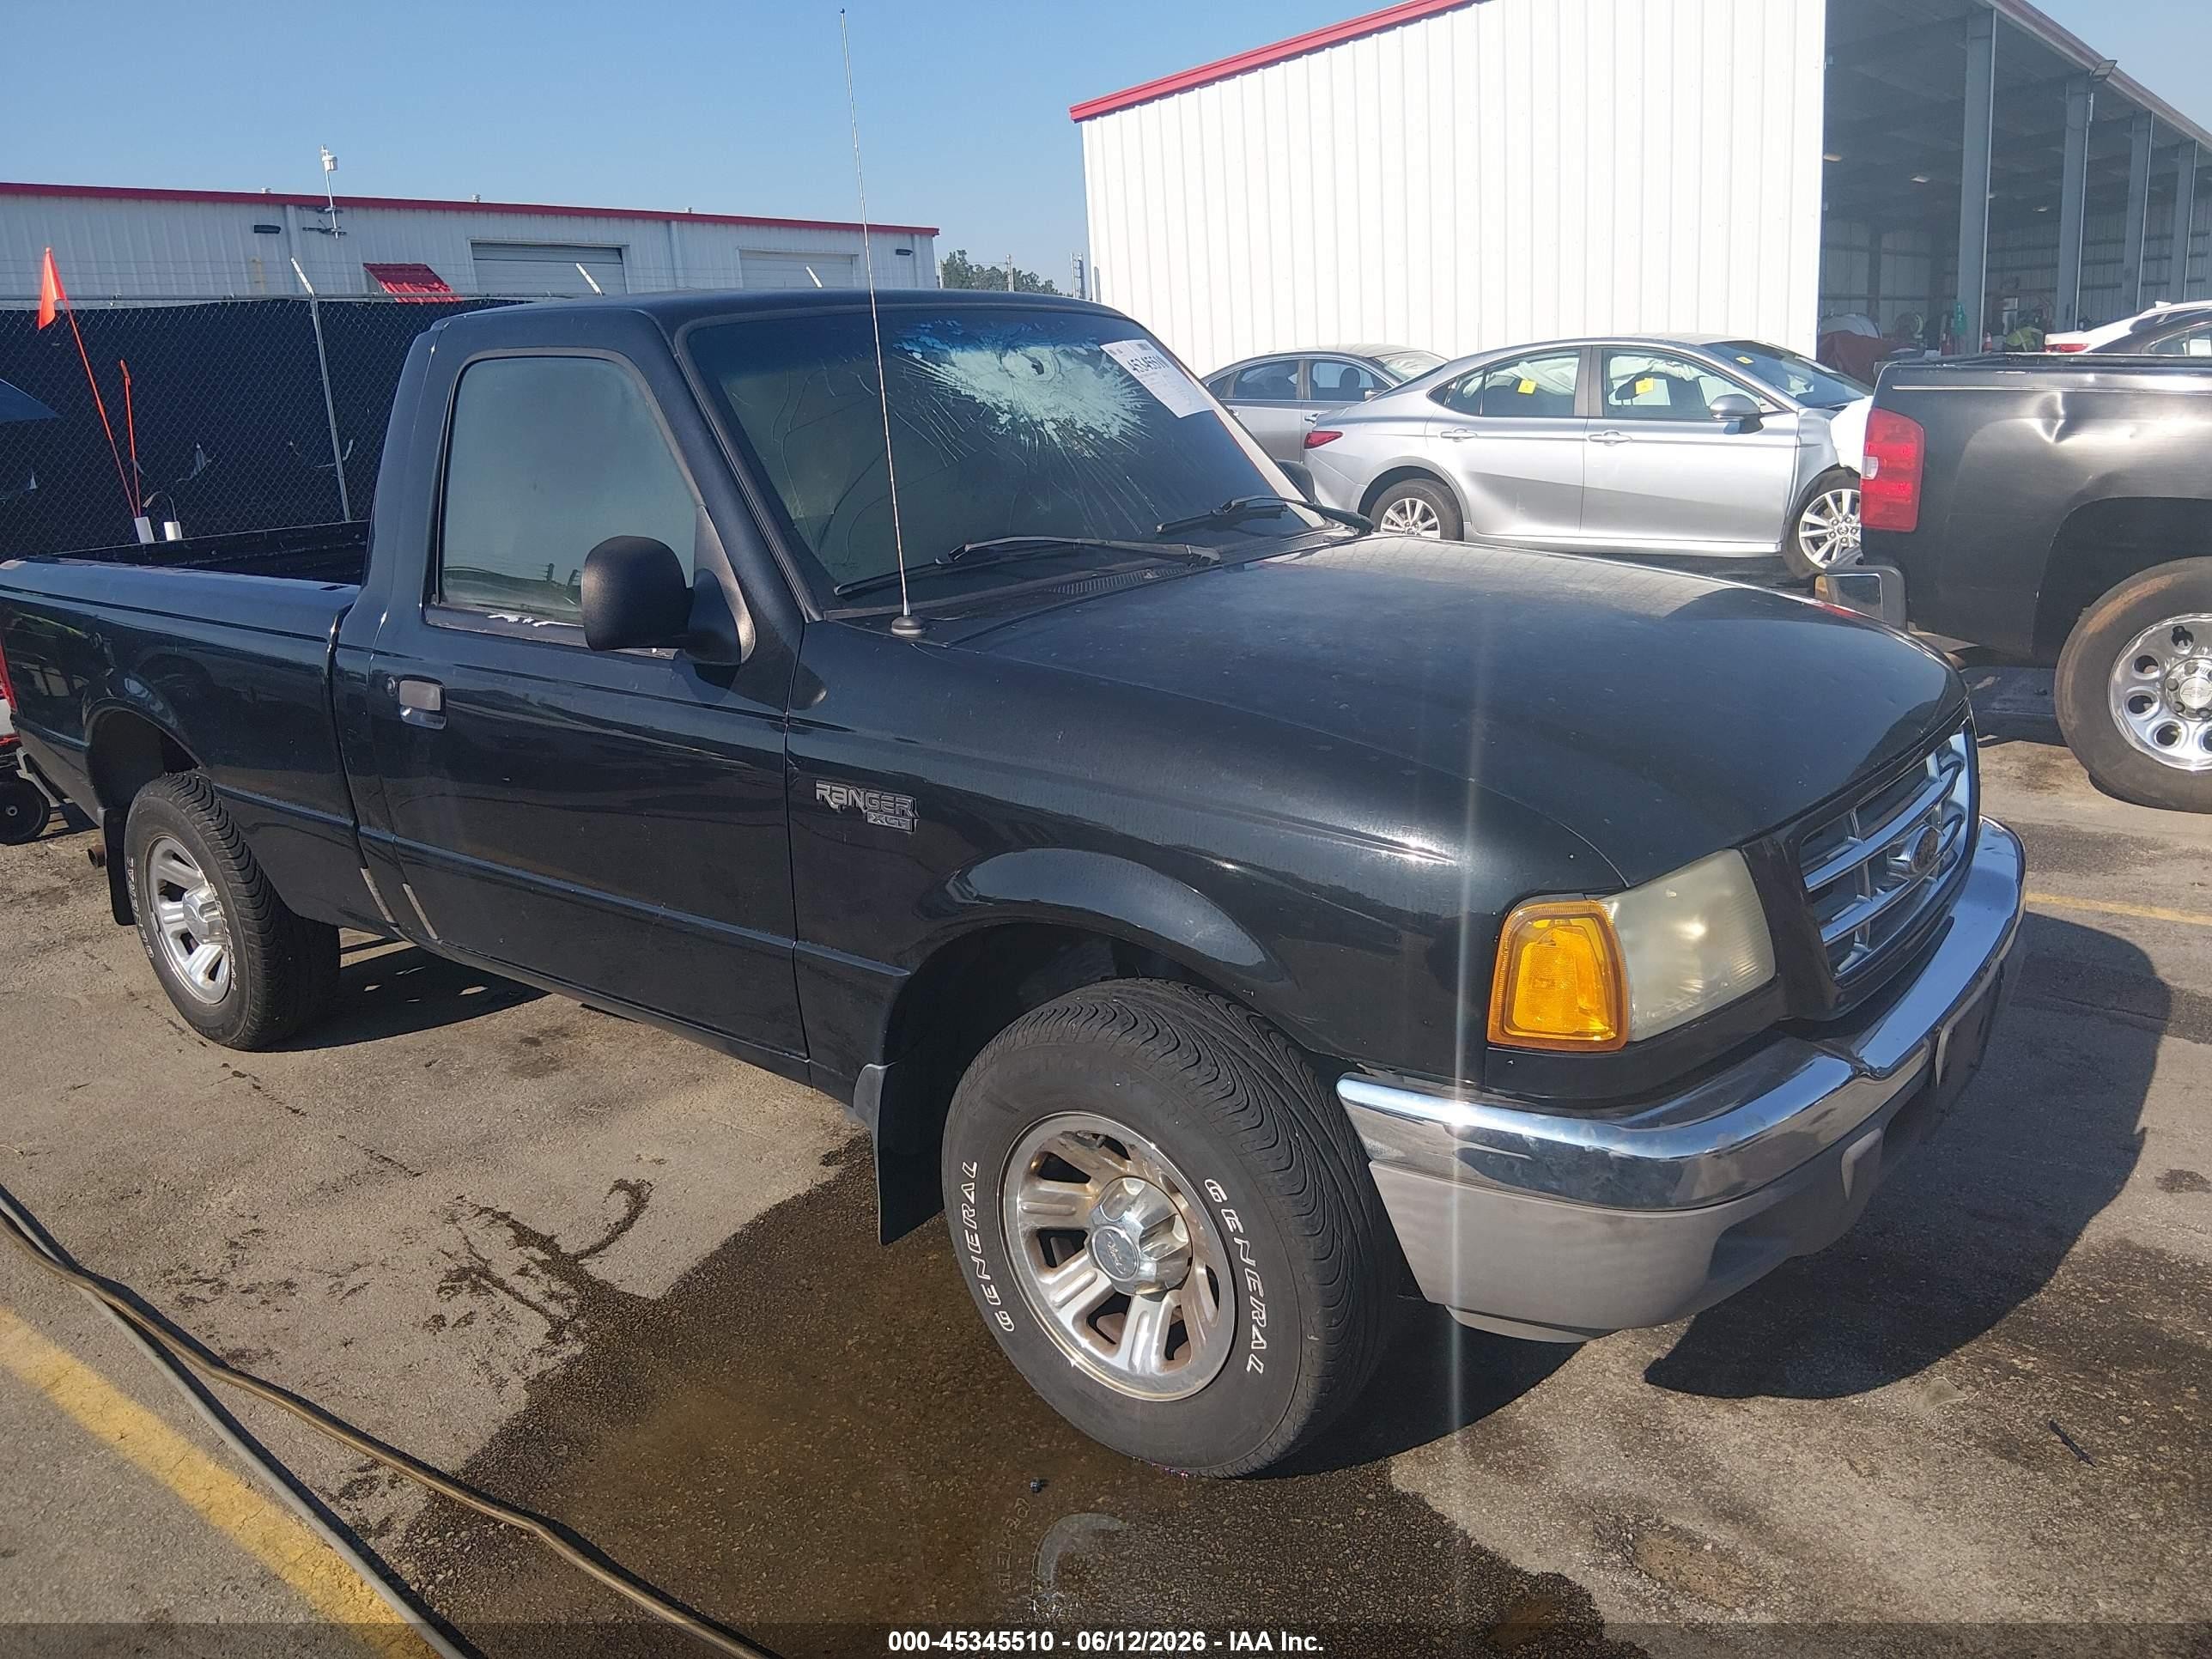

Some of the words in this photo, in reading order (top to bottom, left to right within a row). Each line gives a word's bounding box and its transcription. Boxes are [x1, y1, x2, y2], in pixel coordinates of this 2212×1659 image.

[871, 813, 910, 831] XLT
[959, 1160, 1017, 1334] GENERAL
[1203, 1177, 1269, 1376] GENERAL
